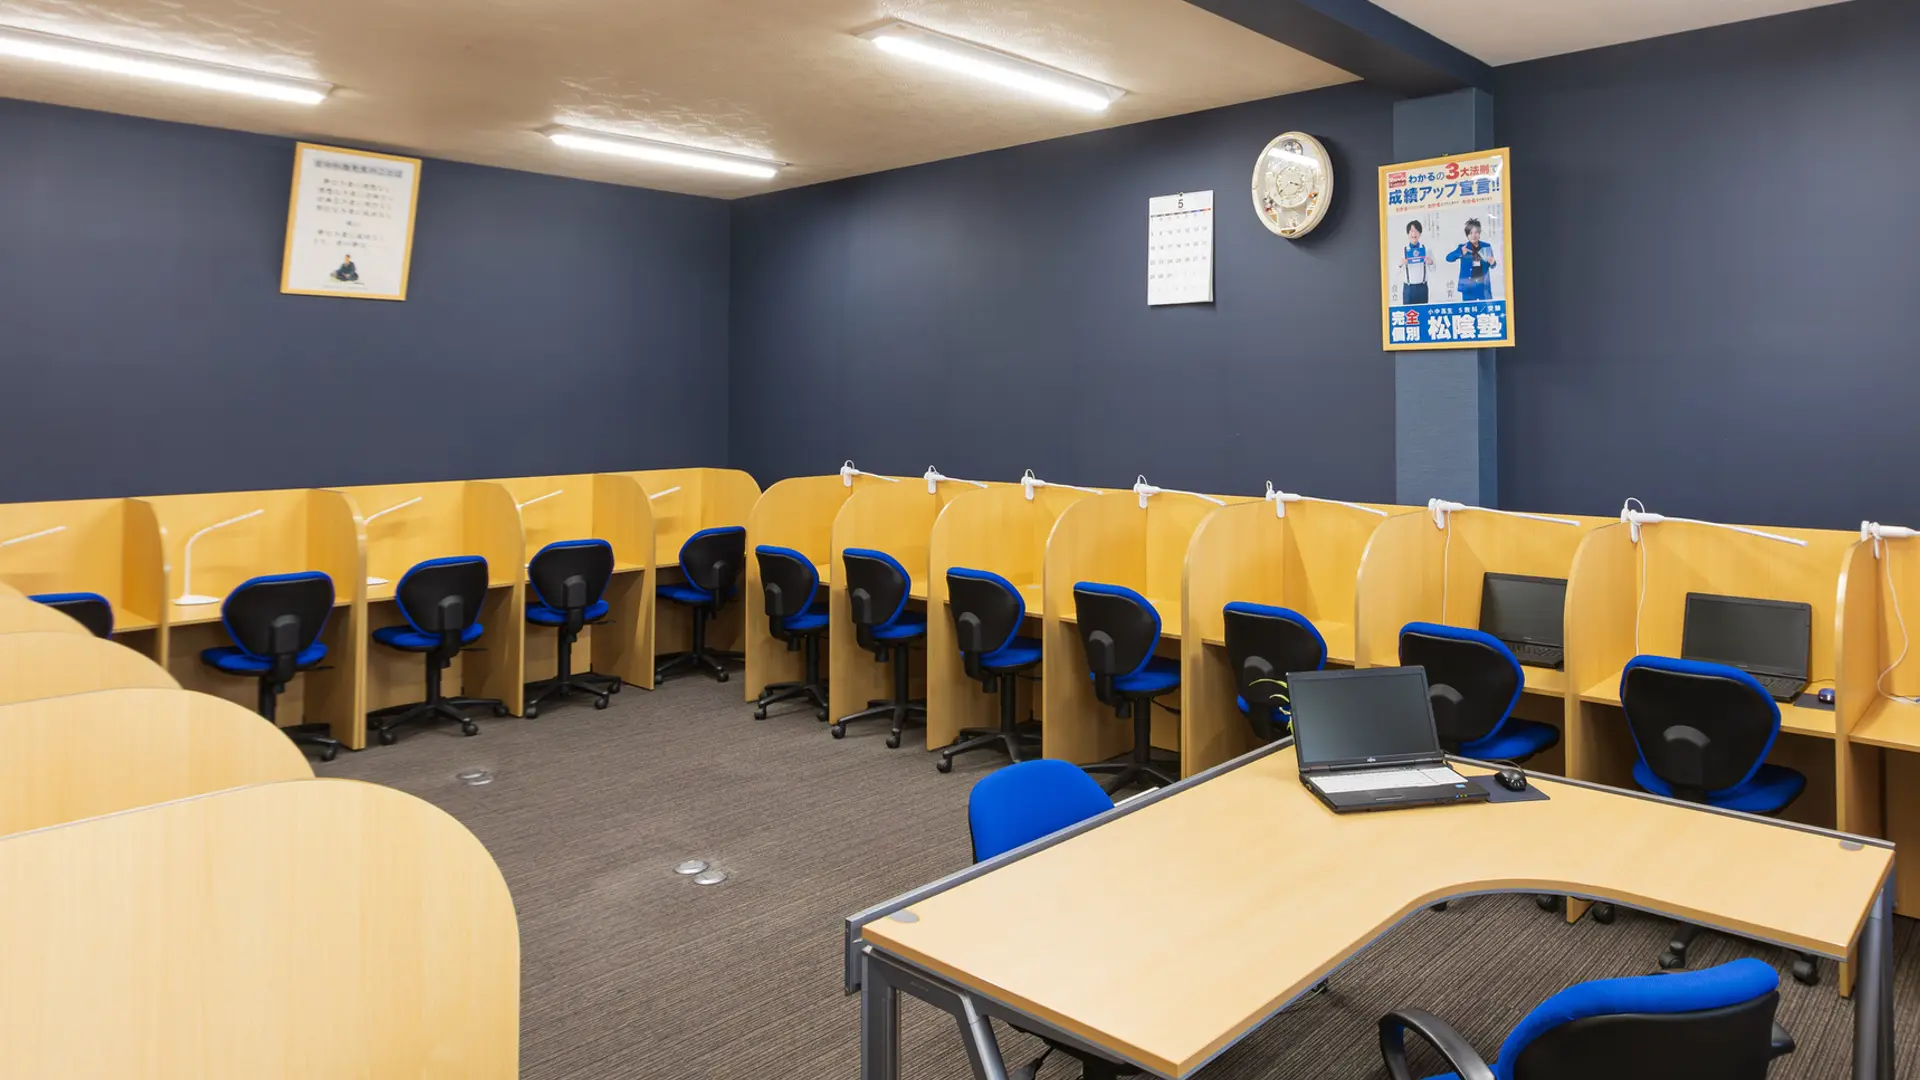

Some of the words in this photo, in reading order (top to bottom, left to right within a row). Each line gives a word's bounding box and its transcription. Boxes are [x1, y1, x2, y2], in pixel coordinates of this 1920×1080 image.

[1178, 199, 1183, 208] 5
[1428, 313, 1502, 340] 松陰塾
